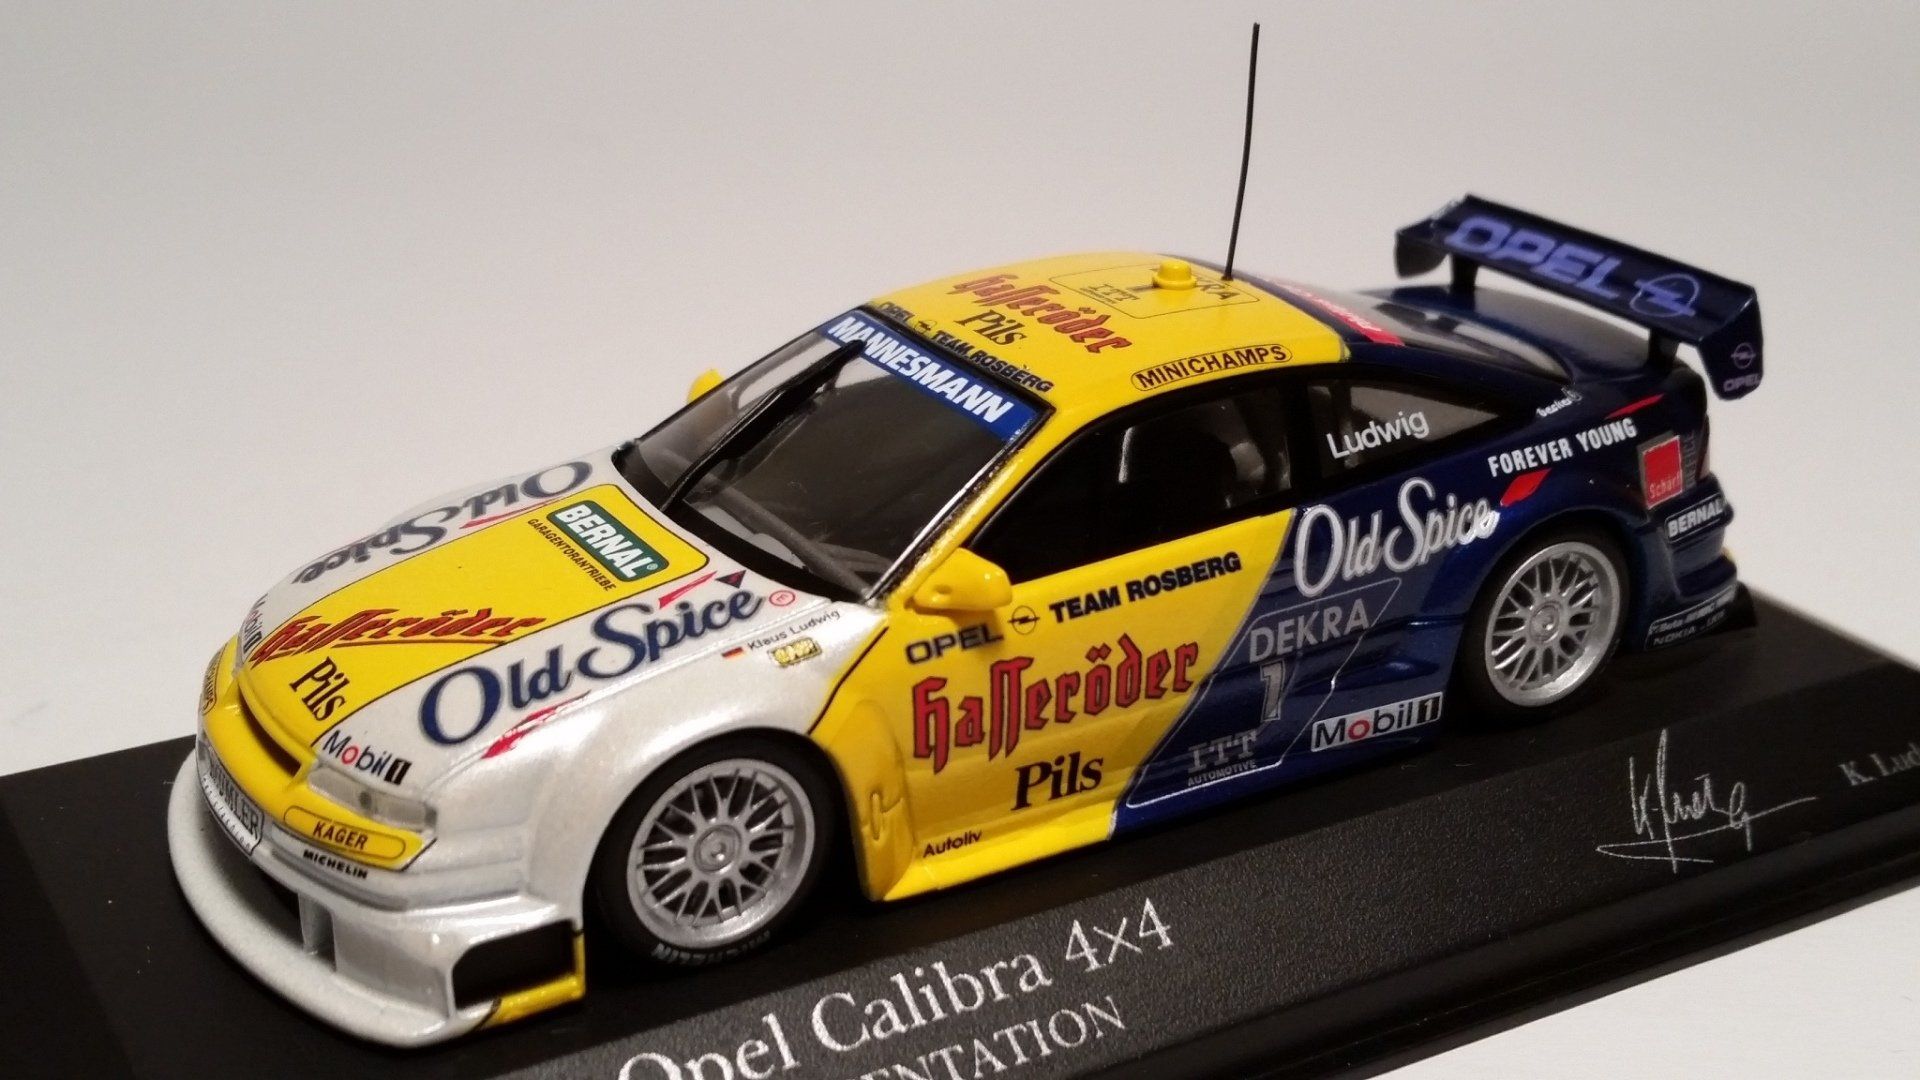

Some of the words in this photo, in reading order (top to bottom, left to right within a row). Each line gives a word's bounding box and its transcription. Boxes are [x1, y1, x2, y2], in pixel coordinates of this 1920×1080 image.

[1444, 214, 1623, 299] OPEL
[954, 309, 1027, 345] Pils
[828, 316, 1014, 423] MANNESMANN
[931, 330, 975, 358] TEAM
[970, 350, 1054, 392] ROSBERG
[1137, 345, 1287, 389] MINICHAMPS
[1326, 411, 1429, 459] Ludwig
[1487, 438, 1573, 477] FOREVER
[1576, 418, 1638, 452] YOUNG
[1295, 504, 1384, 597] Old
[1383, 477, 1500, 572] Spice
[1668, 498, 1726, 538] BERNAL
[528, 519, 616, 591] GARAGENTORANTRIEBE
[1049, 588, 1122, 624] TEAM
[1127, 551, 1242, 603] ROSBERG
[747, 631, 787, 650] Klaus
[789, 610, 840, 635] Ludwig
[905, 624, 1004, 666] OPEL
[1251, 599, 1370, 663] DEKRA
[289, 656, 350, 721] Pils
[419, 645, 573, 745] Old
[577, 590, 764, 678] Spice
[1259, 660, 1287, 722] 1
[1188, 729, 1257, 772] ITT
[1188, 760, 1257, 786] AUTOMOTIVE
[1010, 751, 1104, 811] Pils
[303, 850, 368, 879] MICHELIN
[312, 820, 368, 850] KAGER
[922, 829, 983, 858] Autoliv
[811, 954, 1053, 1053] Calibra
[857, 995, 1126, 1080] NTATION
